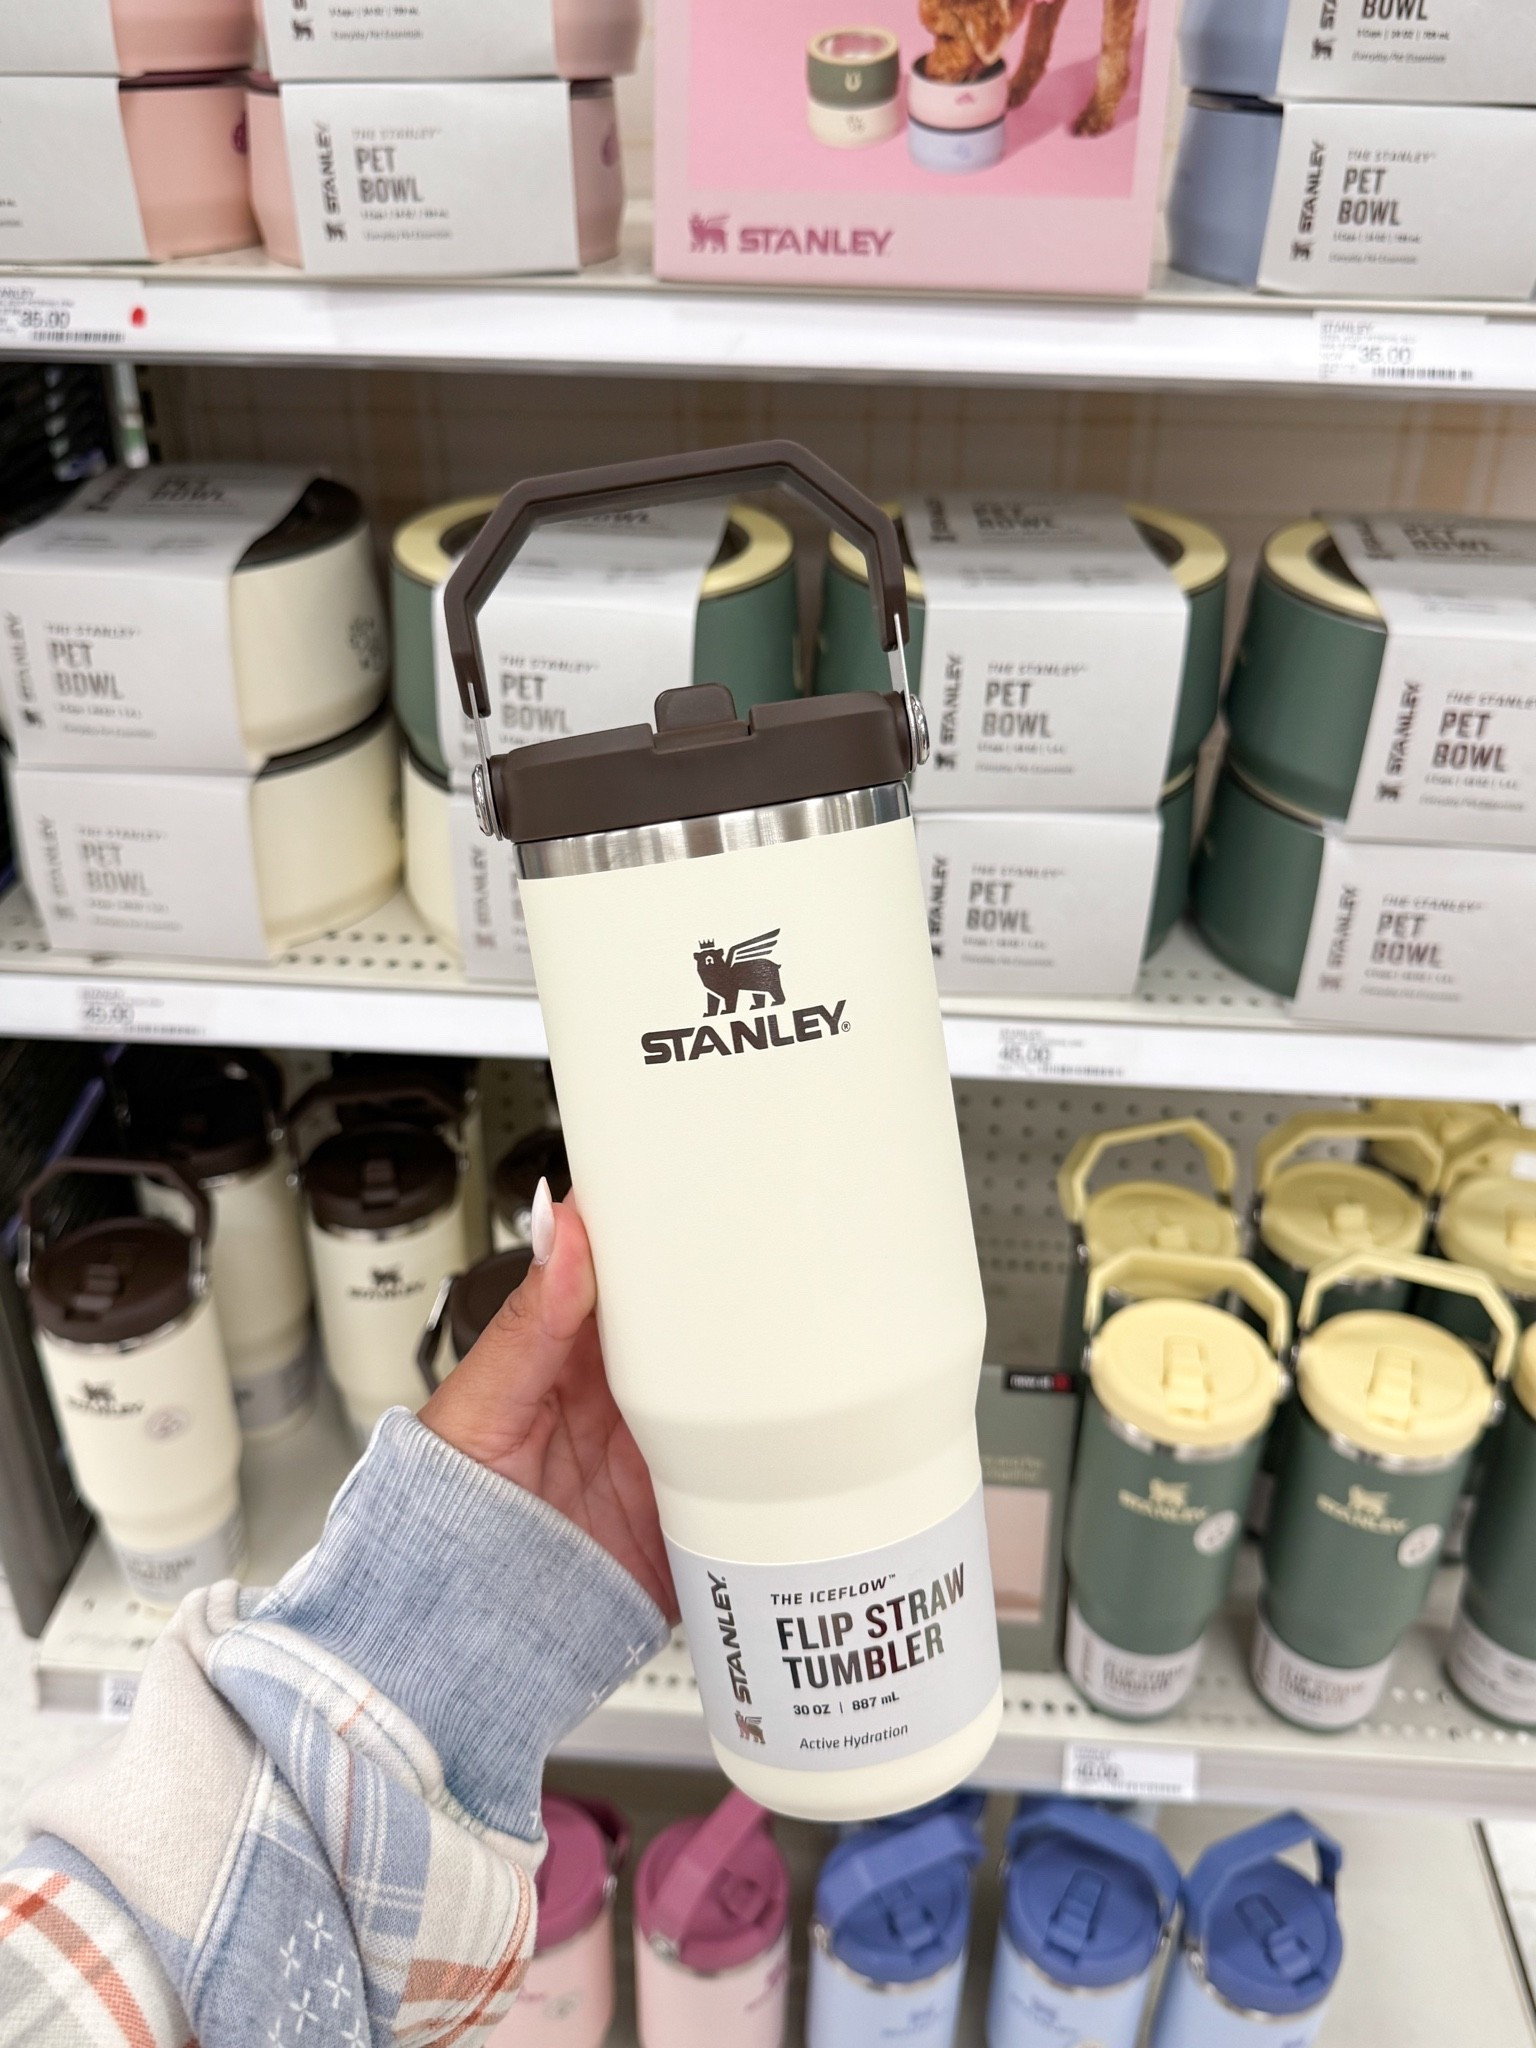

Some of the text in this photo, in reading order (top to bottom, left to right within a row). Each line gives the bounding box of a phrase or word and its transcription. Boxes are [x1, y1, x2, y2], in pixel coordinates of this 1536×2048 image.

[1361, 0, 1428, 20] BOWL
[314, 121, 340, 214] STANLEY
[355, 147, 396, 173] PET
[358, 177, 424, 203] BOWL
[1298, 139, 1325, 234] STANLEY
[1343, 167, 1387, 194] PET
[1337, 199, 1401, 226] BOWL
[738, 226, 895, 256] STANLEY
[48, 642, 93, 668] PET
[55, 672, 125, 699] BOWL
[501, 674, 547, 702] PET
[940, 653, 962, 745] STANLEY
[985, 681, 1032, 707] PET
[501, 704, 573, 734] BOWL
[981, 712, 1052, 738] BOWL
[1440, 710, 1492, 739] PET
[1432, 742, 1508, 773] BOWL
[86, 870, 152, 897] BOWL
[969, 881, 1014, 906] PET
[966, 908, 1033, 934] BOWL
[1376, 912, 1427, 938] PET
[1371, 939, 1442, 969] BOWL
[771, 1592, 803, 1605] THE
[776, 1561, 965, 1650] FLIP STRAW
[782, 1621, 945, 1689] TUMBLER
[793, 1691, 900, 1715] 30 OZ 887 mL
[800, 1724, 909, 1750] Active Hydration
